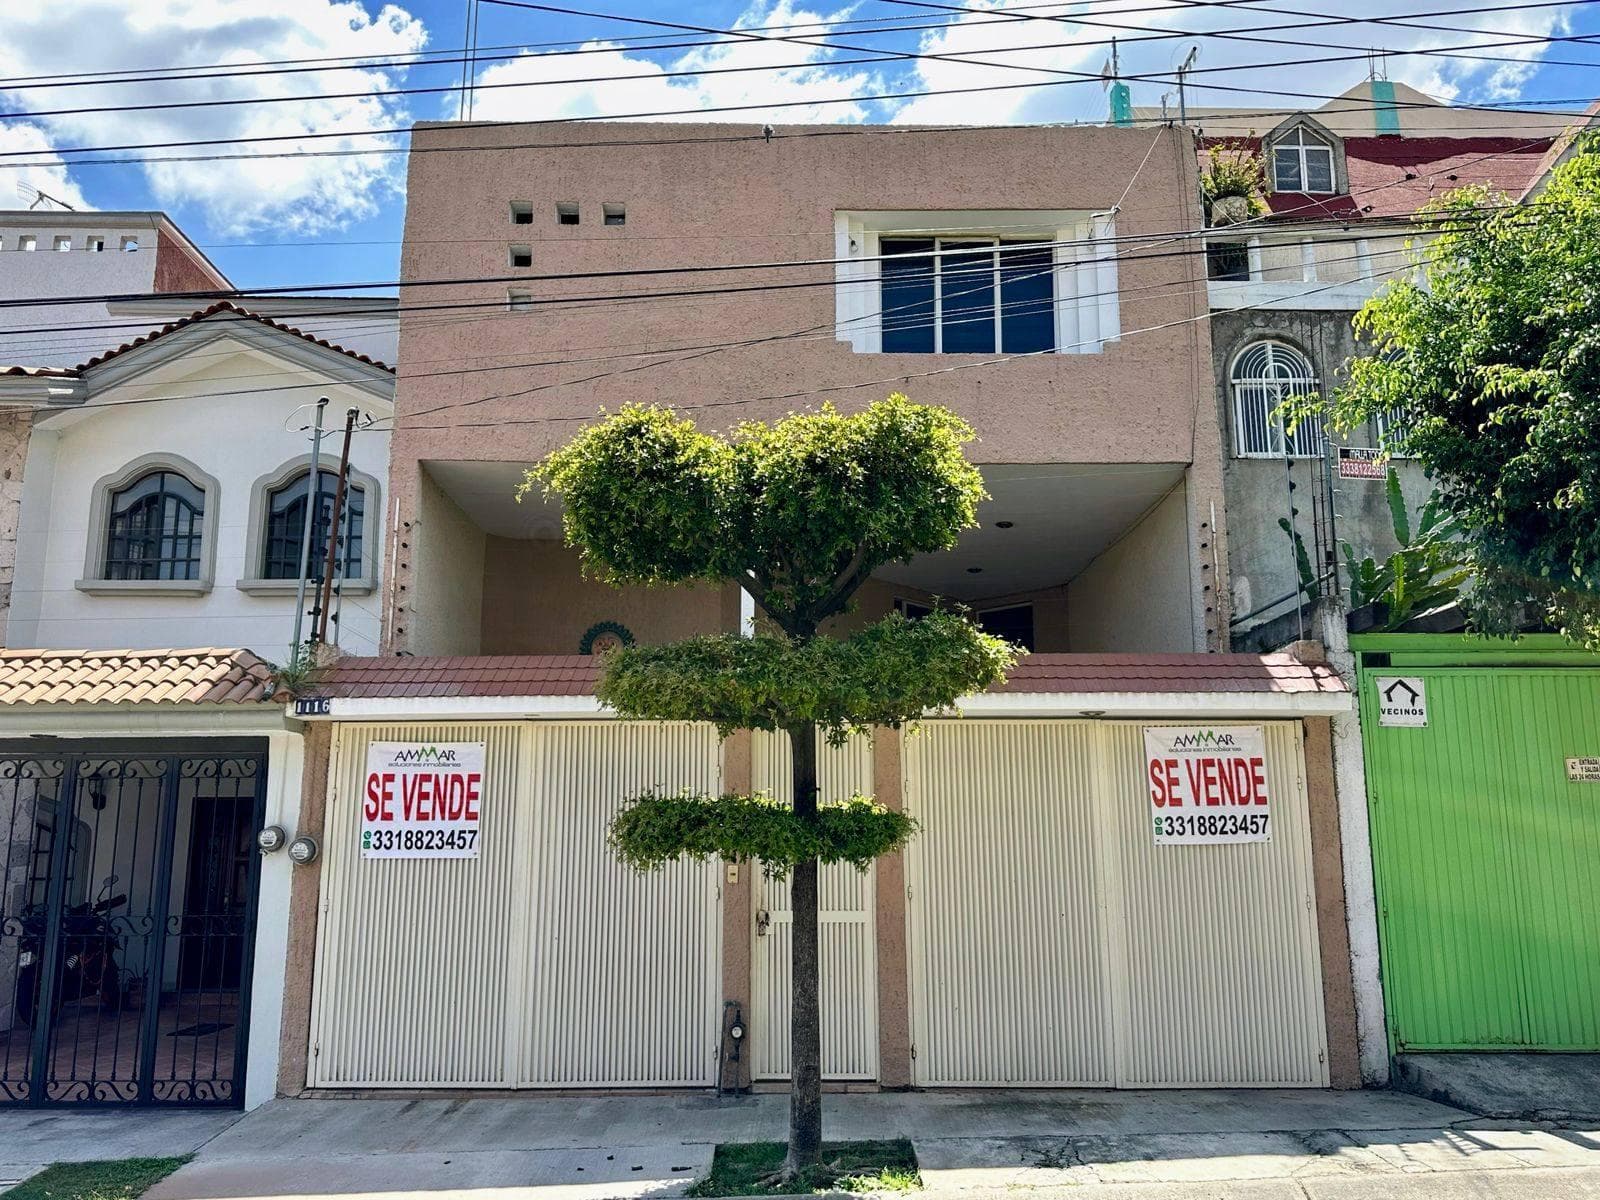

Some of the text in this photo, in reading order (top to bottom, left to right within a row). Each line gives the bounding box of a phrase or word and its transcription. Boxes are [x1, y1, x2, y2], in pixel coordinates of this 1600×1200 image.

[296, 700, 329, 713] 1116
[1381, 708, 1424, 716] VECINOS
[1173, 730, 1235, 748] AMMAR
[394, 746, 456, 762] AMMAR
[1150, 757, 1268, 808] SE VENDE
[365, 773, 481, 822] SE VENDE
[1164, 814, 1269, 836] 3318823457
[372, 830, 478, 850] 3318823457
